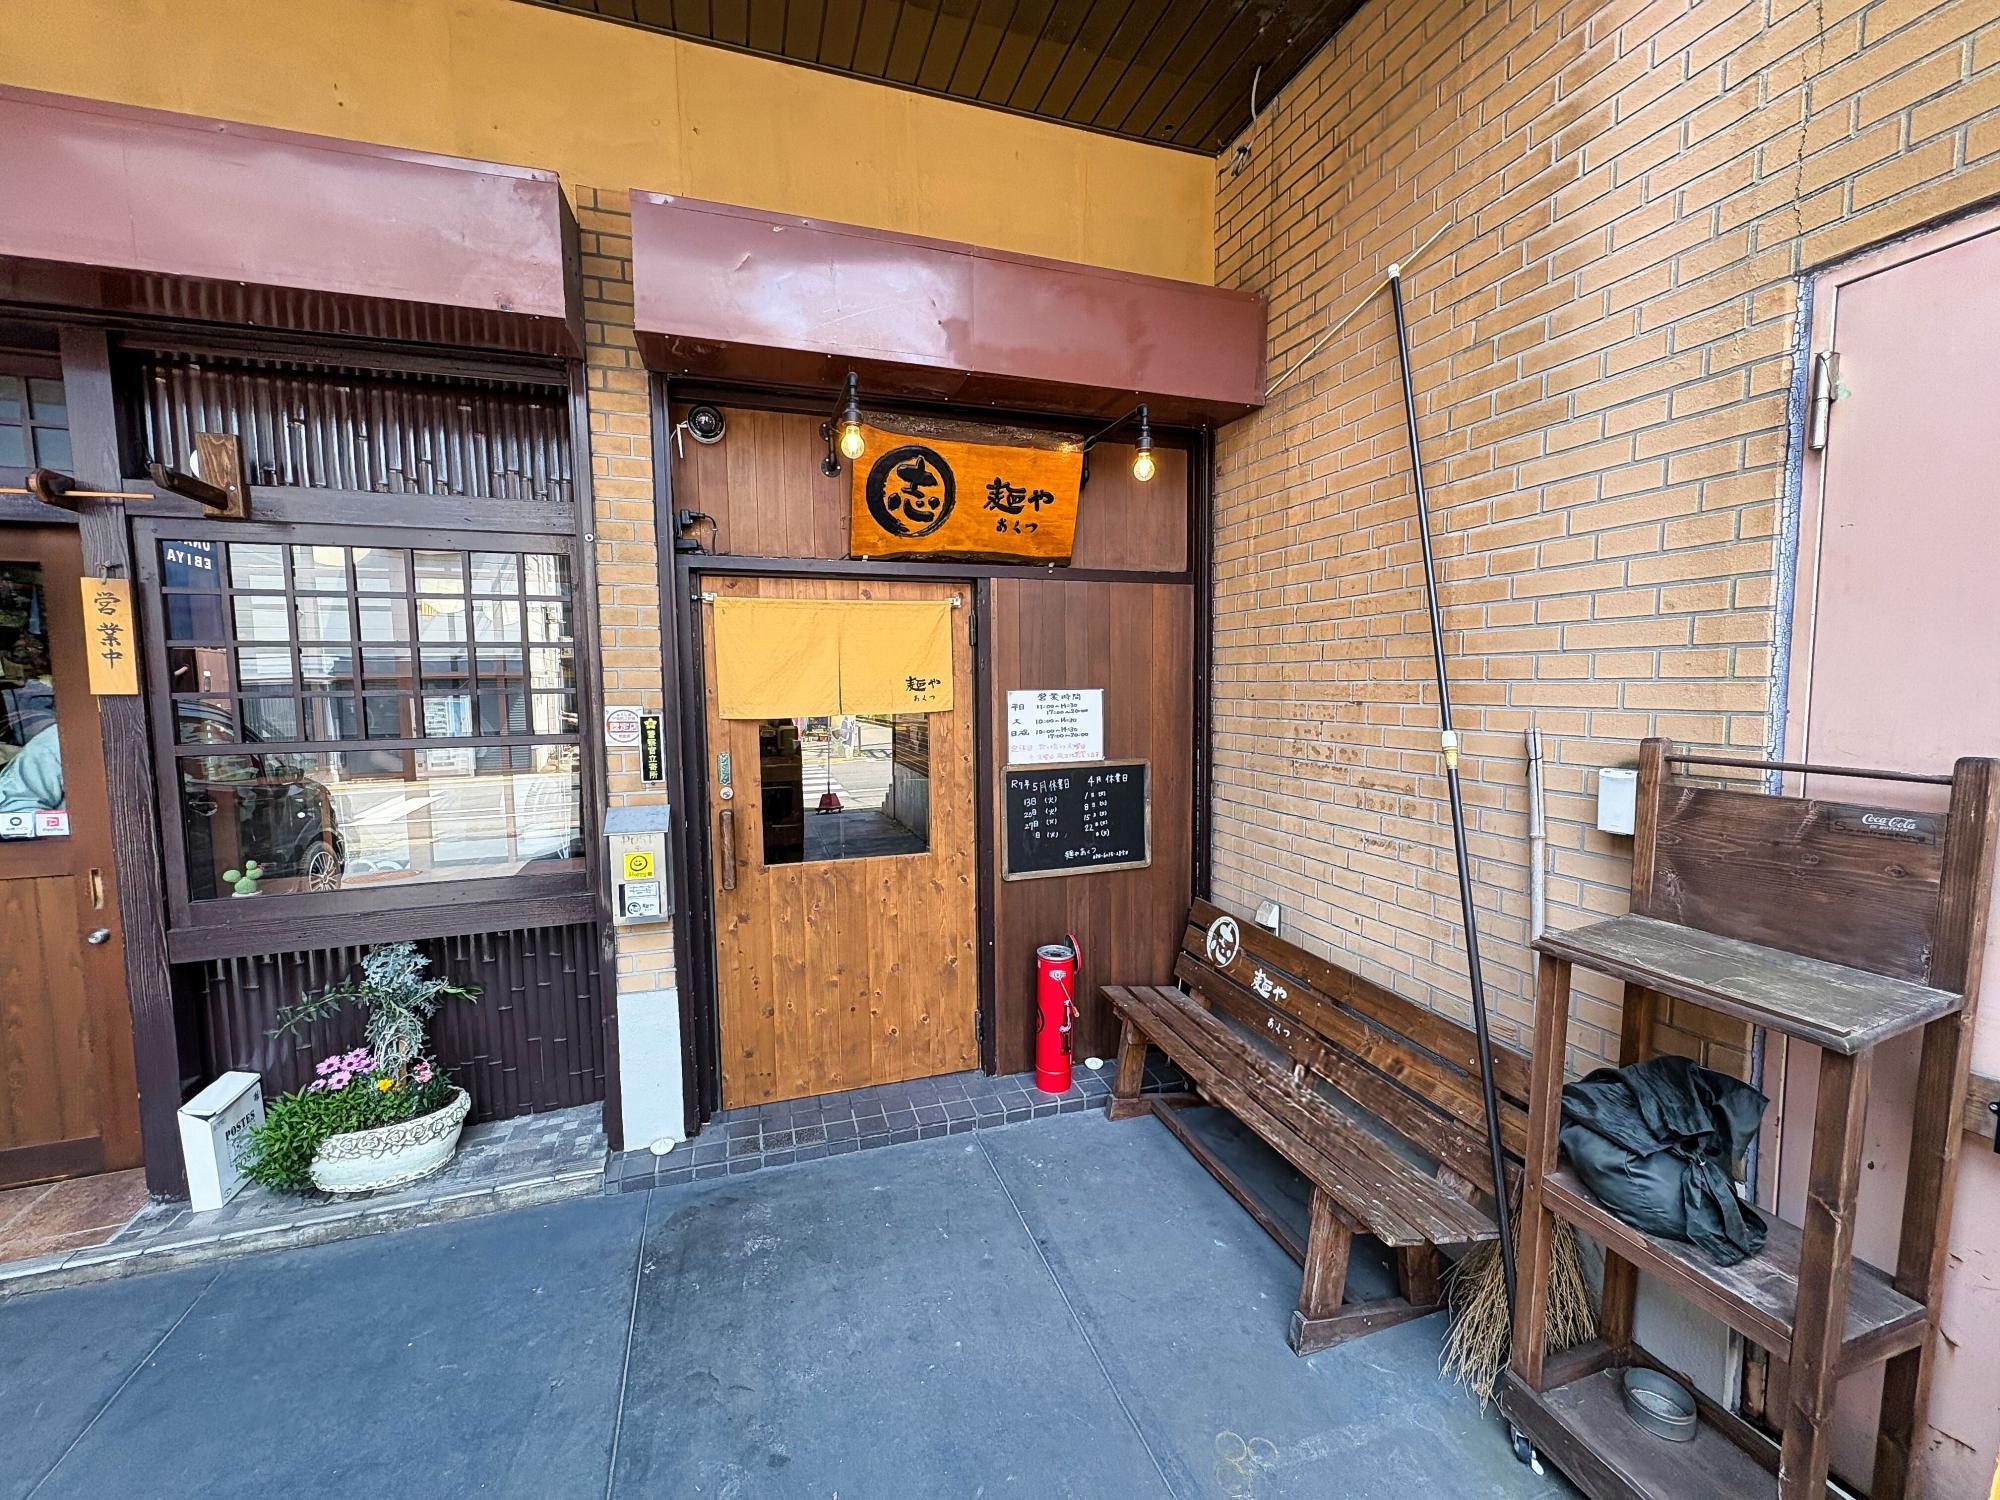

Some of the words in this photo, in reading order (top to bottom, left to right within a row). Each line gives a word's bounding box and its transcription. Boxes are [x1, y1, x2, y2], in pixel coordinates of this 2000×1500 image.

[983, 476, 1055, 515] 麺や
[94, 591, 124, 670] 営業中
[905, 675, 943, 692] 麺や
[1037, 692, 1082, 701] 営業時間
[1251, 968, 1288, 1002] 麺や
[224, 1108, 256, 1142] POSTES
